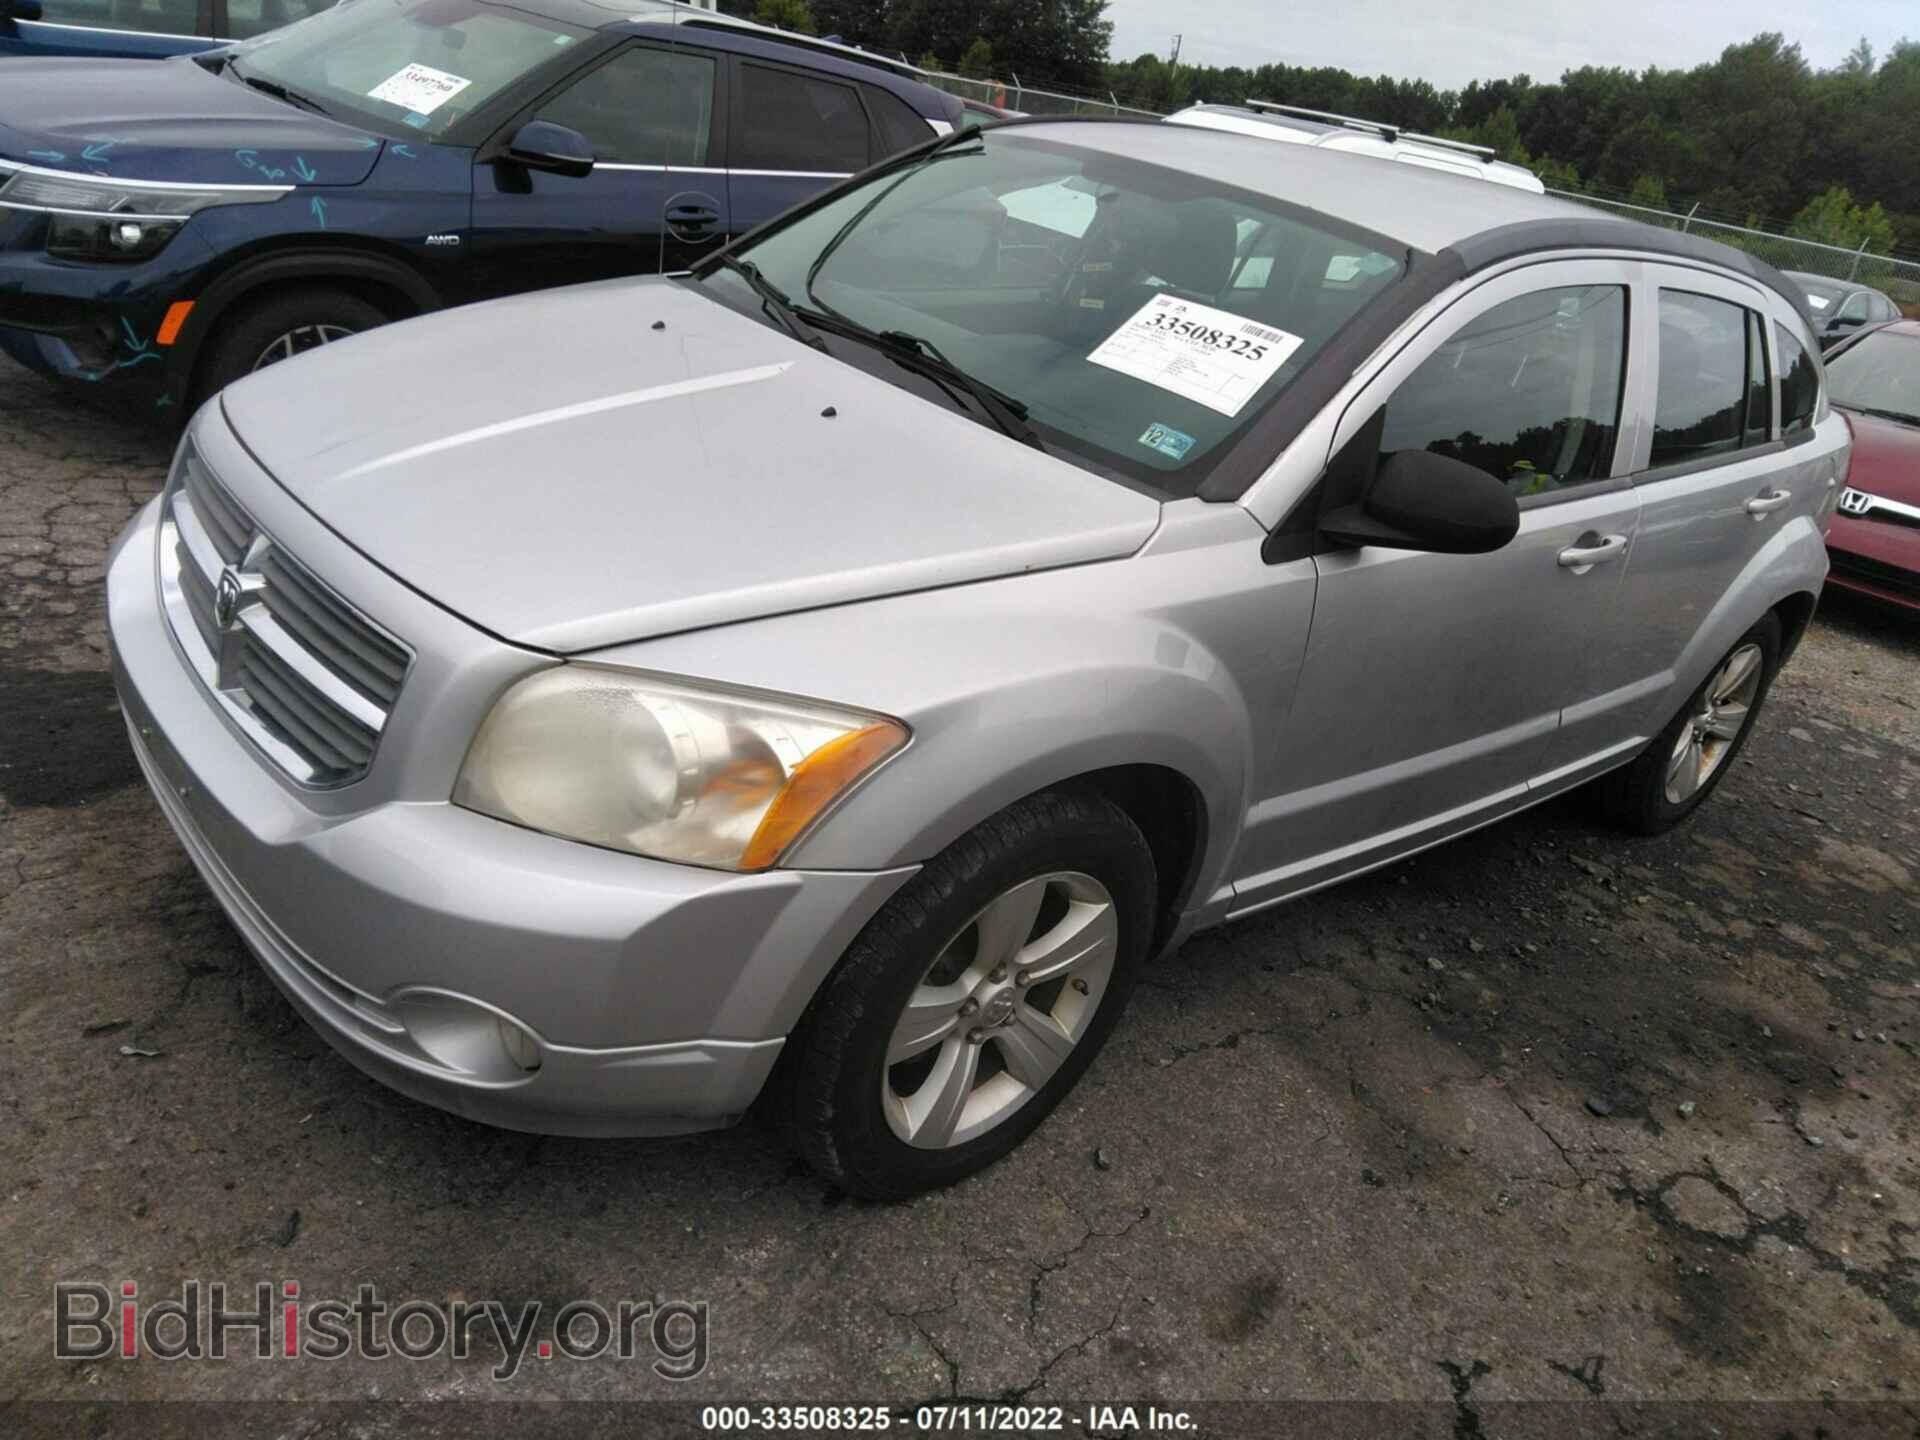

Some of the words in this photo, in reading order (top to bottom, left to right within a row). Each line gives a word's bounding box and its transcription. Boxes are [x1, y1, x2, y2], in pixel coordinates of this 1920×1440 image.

[424, 235, 460, 246] AWD
[1145, 312, 1269, 361] 33508325
[1145, 424, 1165, 444] 12
